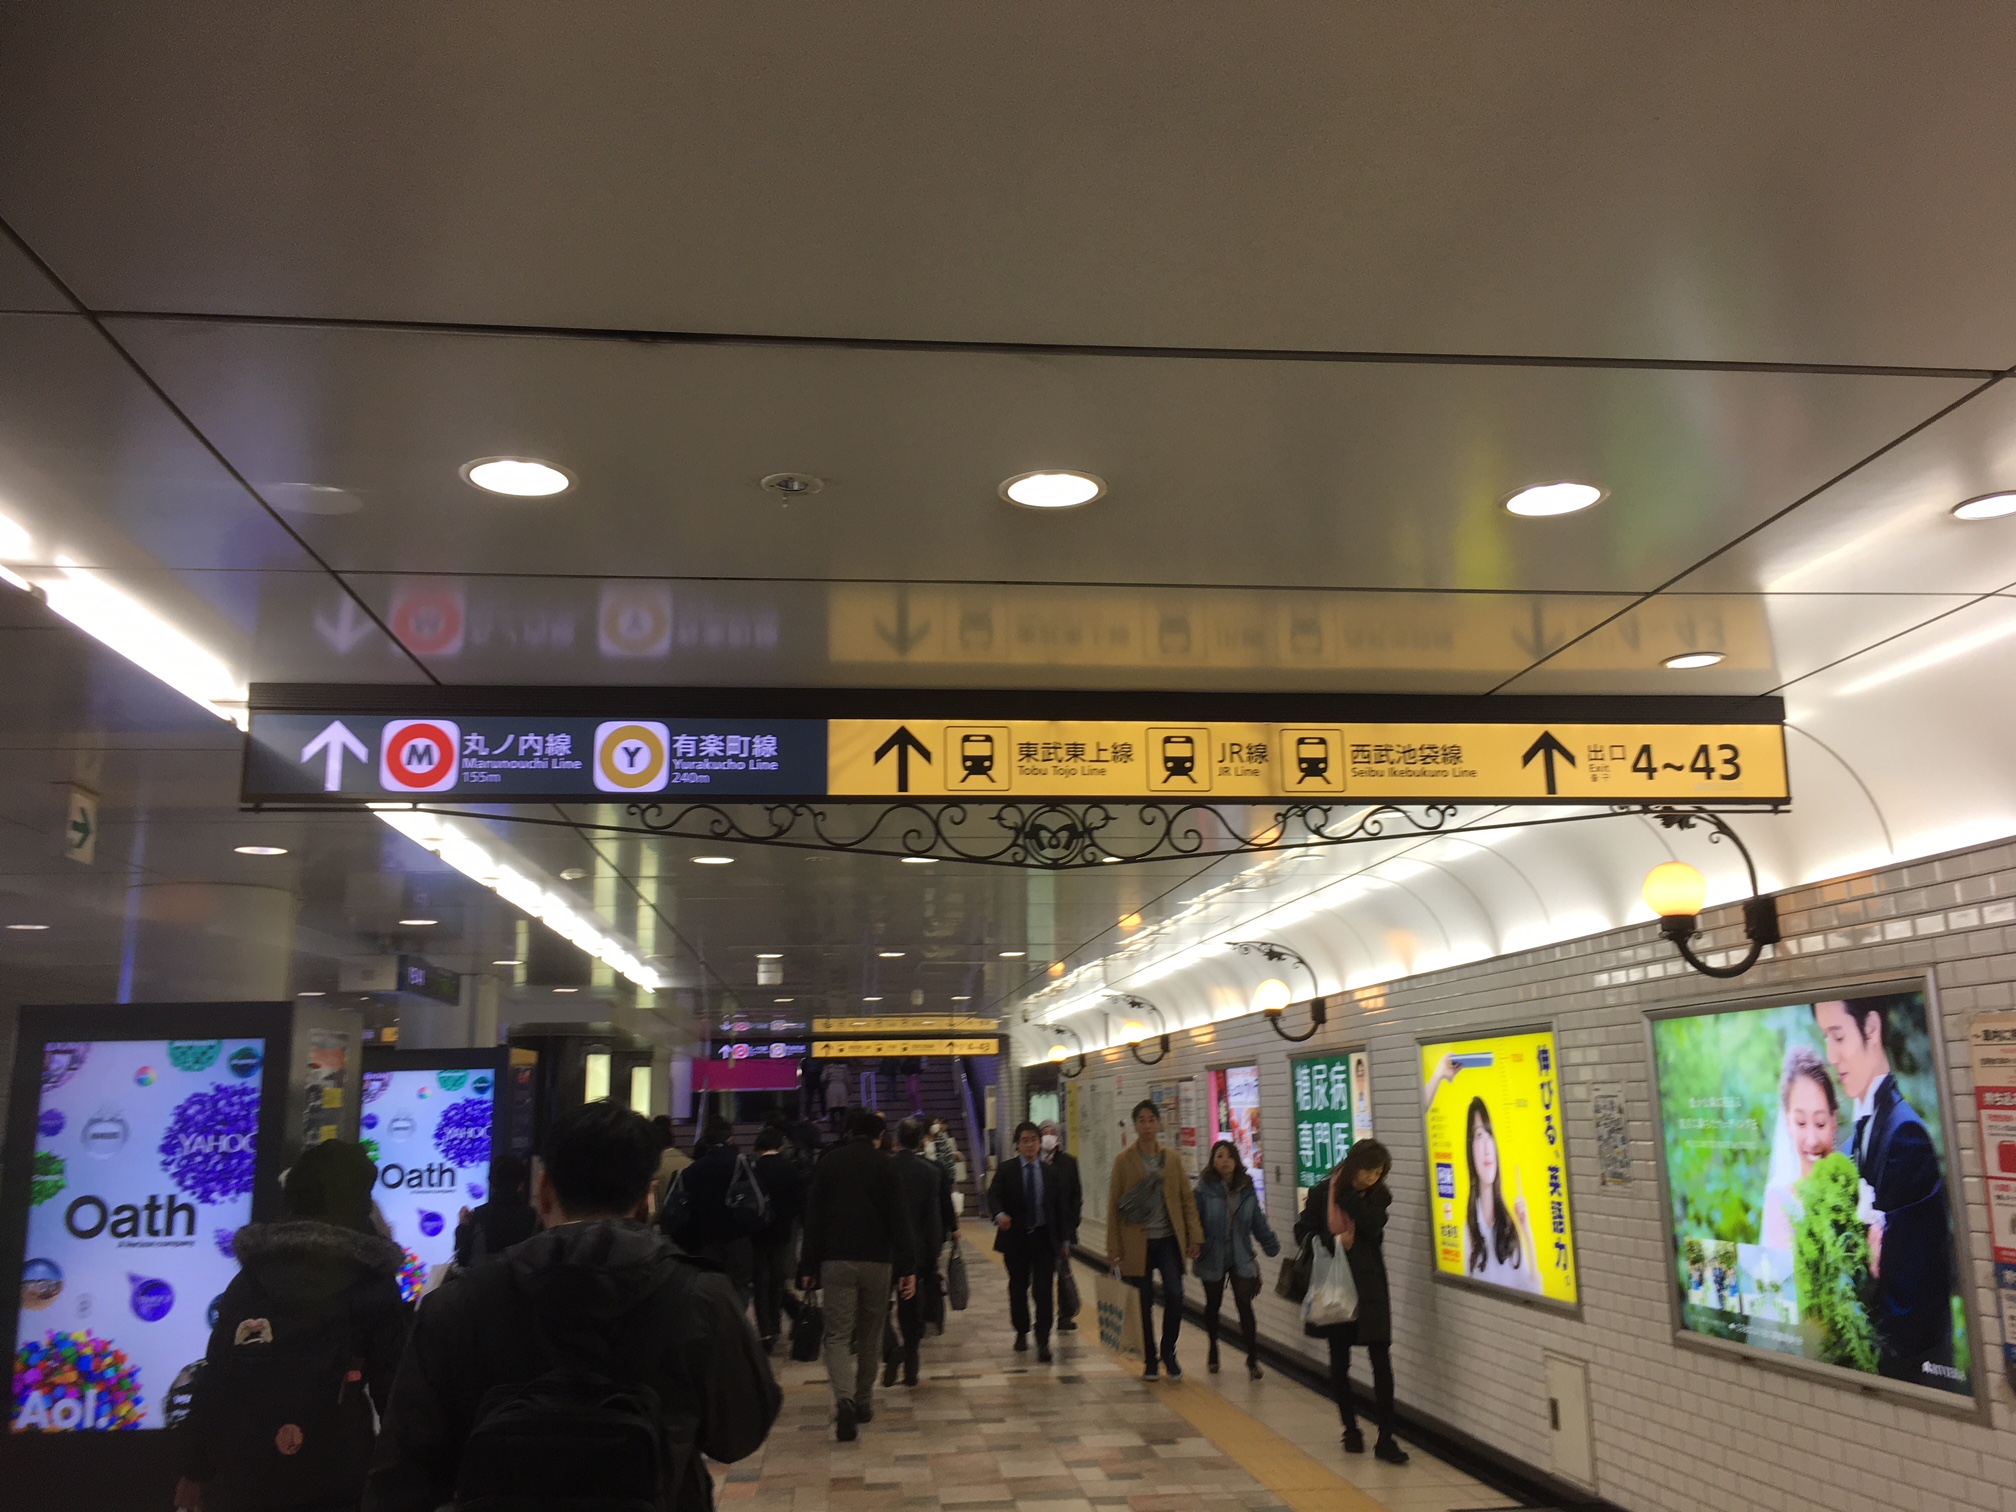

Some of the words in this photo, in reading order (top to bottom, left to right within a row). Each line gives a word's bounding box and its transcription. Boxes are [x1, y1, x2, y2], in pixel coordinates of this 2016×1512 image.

[462, 732, 572, 756] 丸ノ内線
[672, 733, 779, 757] 有楽町線
[1017, 741, 1135, 763] 東武東上線
[1217, 743, 1269, 764] JR線
[1350, 743, 1464, 765] 西武池袋線
[1587, 744, 1627, 761] 出口
[405, 744, 435, 767] M
[461, 758, 549, 769] Marunouchi
[551, 758, 583, 769] Line
[620, 746, 643, 768] Y
[672, 758, 747, 770] Yurakucho
[748, 758, 780, 770] Line
[461, 771, 502, 783] 155m
[671, 772, 711, 783] 240m
[1017, 765, 1048, 776] Tobu
[1051, 765, 1078, 778] Tojo
[1080, 765, 1108, 776] Line
[1217, 766, 1232, 777] JR
[1234, 766, 1260, 777] Line
[1350, 767, 1386, 778] Seibu
[1387, 767, 1450, 778] Ikebukuro
[1452, 767, 1478, 778] Line
[1588, 764, 1611, 773] Exit
[1295, 1061, 1349, 1112] 糖尿病
[1297, 1120, 1350, 1169] 専門医
[381, 1162, 456, 1189] Oath
[66, 1194, 197, 1239] Oath
[15, 1389, 110, 1430] Aol.
